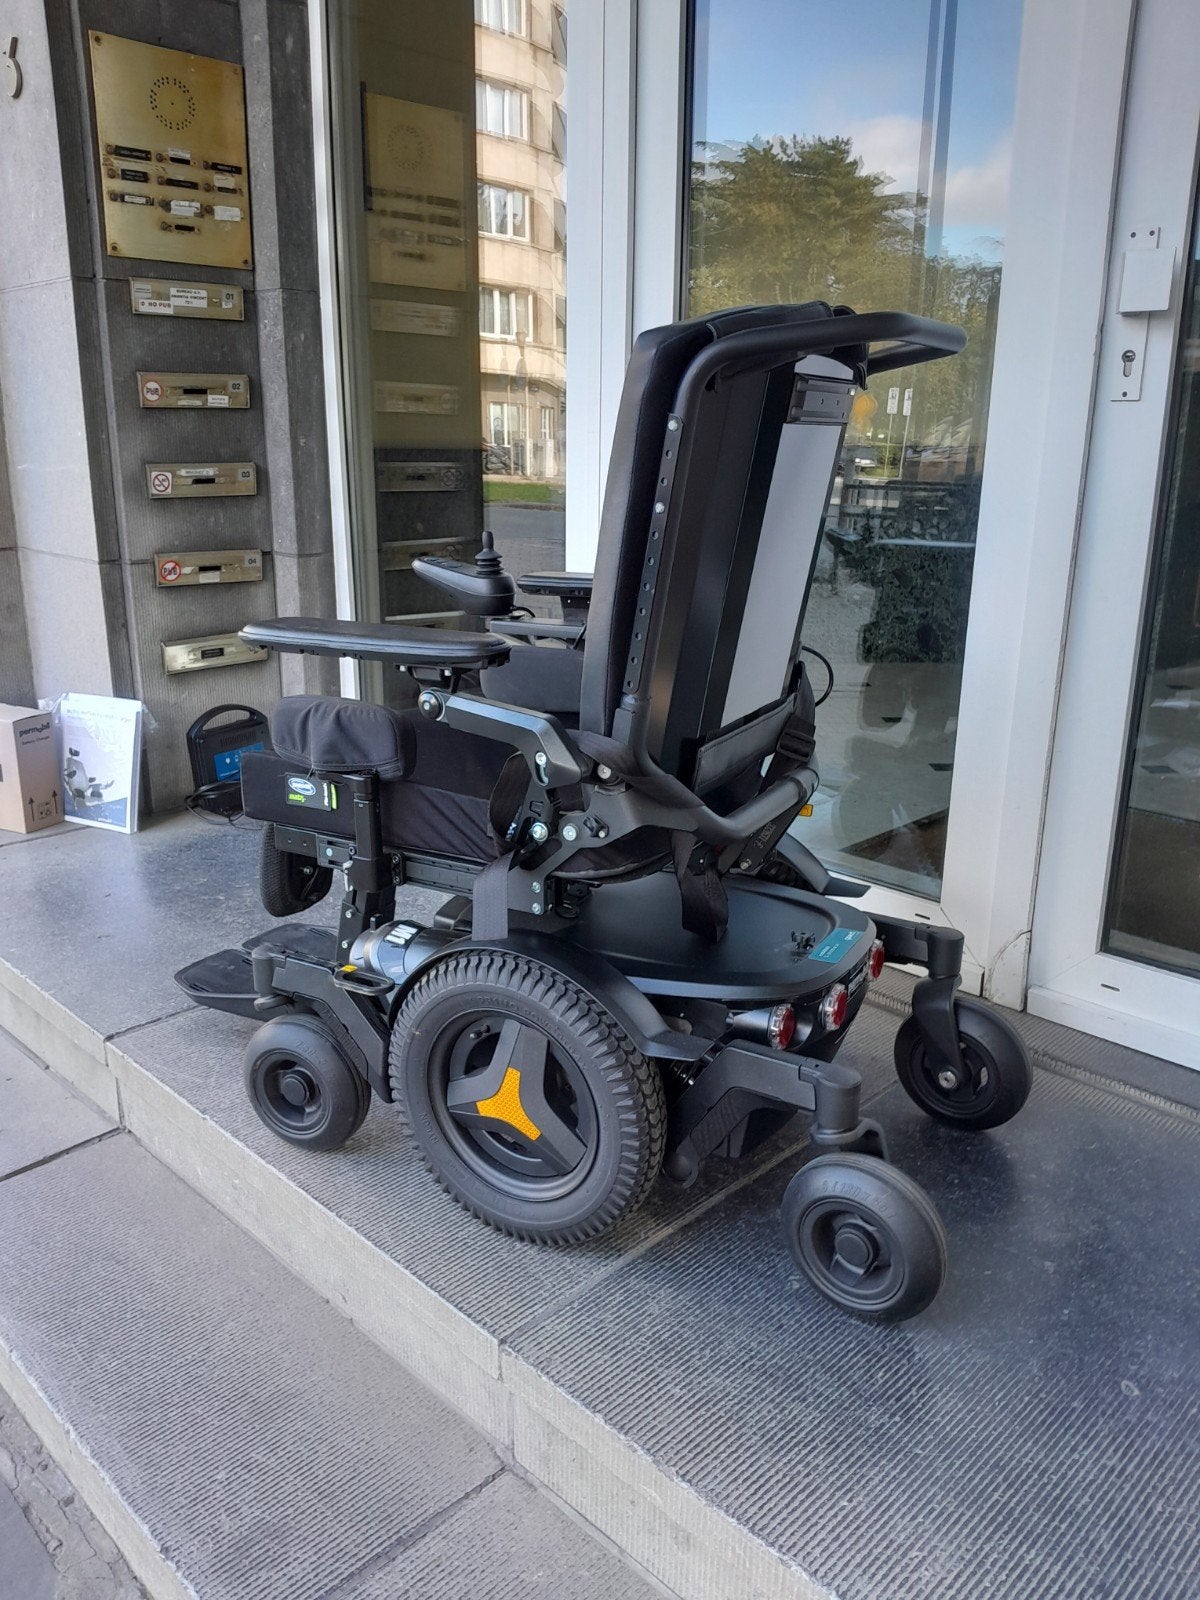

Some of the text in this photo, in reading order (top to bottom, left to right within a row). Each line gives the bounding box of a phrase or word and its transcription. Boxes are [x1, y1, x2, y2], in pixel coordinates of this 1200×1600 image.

[225, 293, 234, 301] 01
[232, 382, 241, 391] 02
[19, 722, 50, 737] permobil
